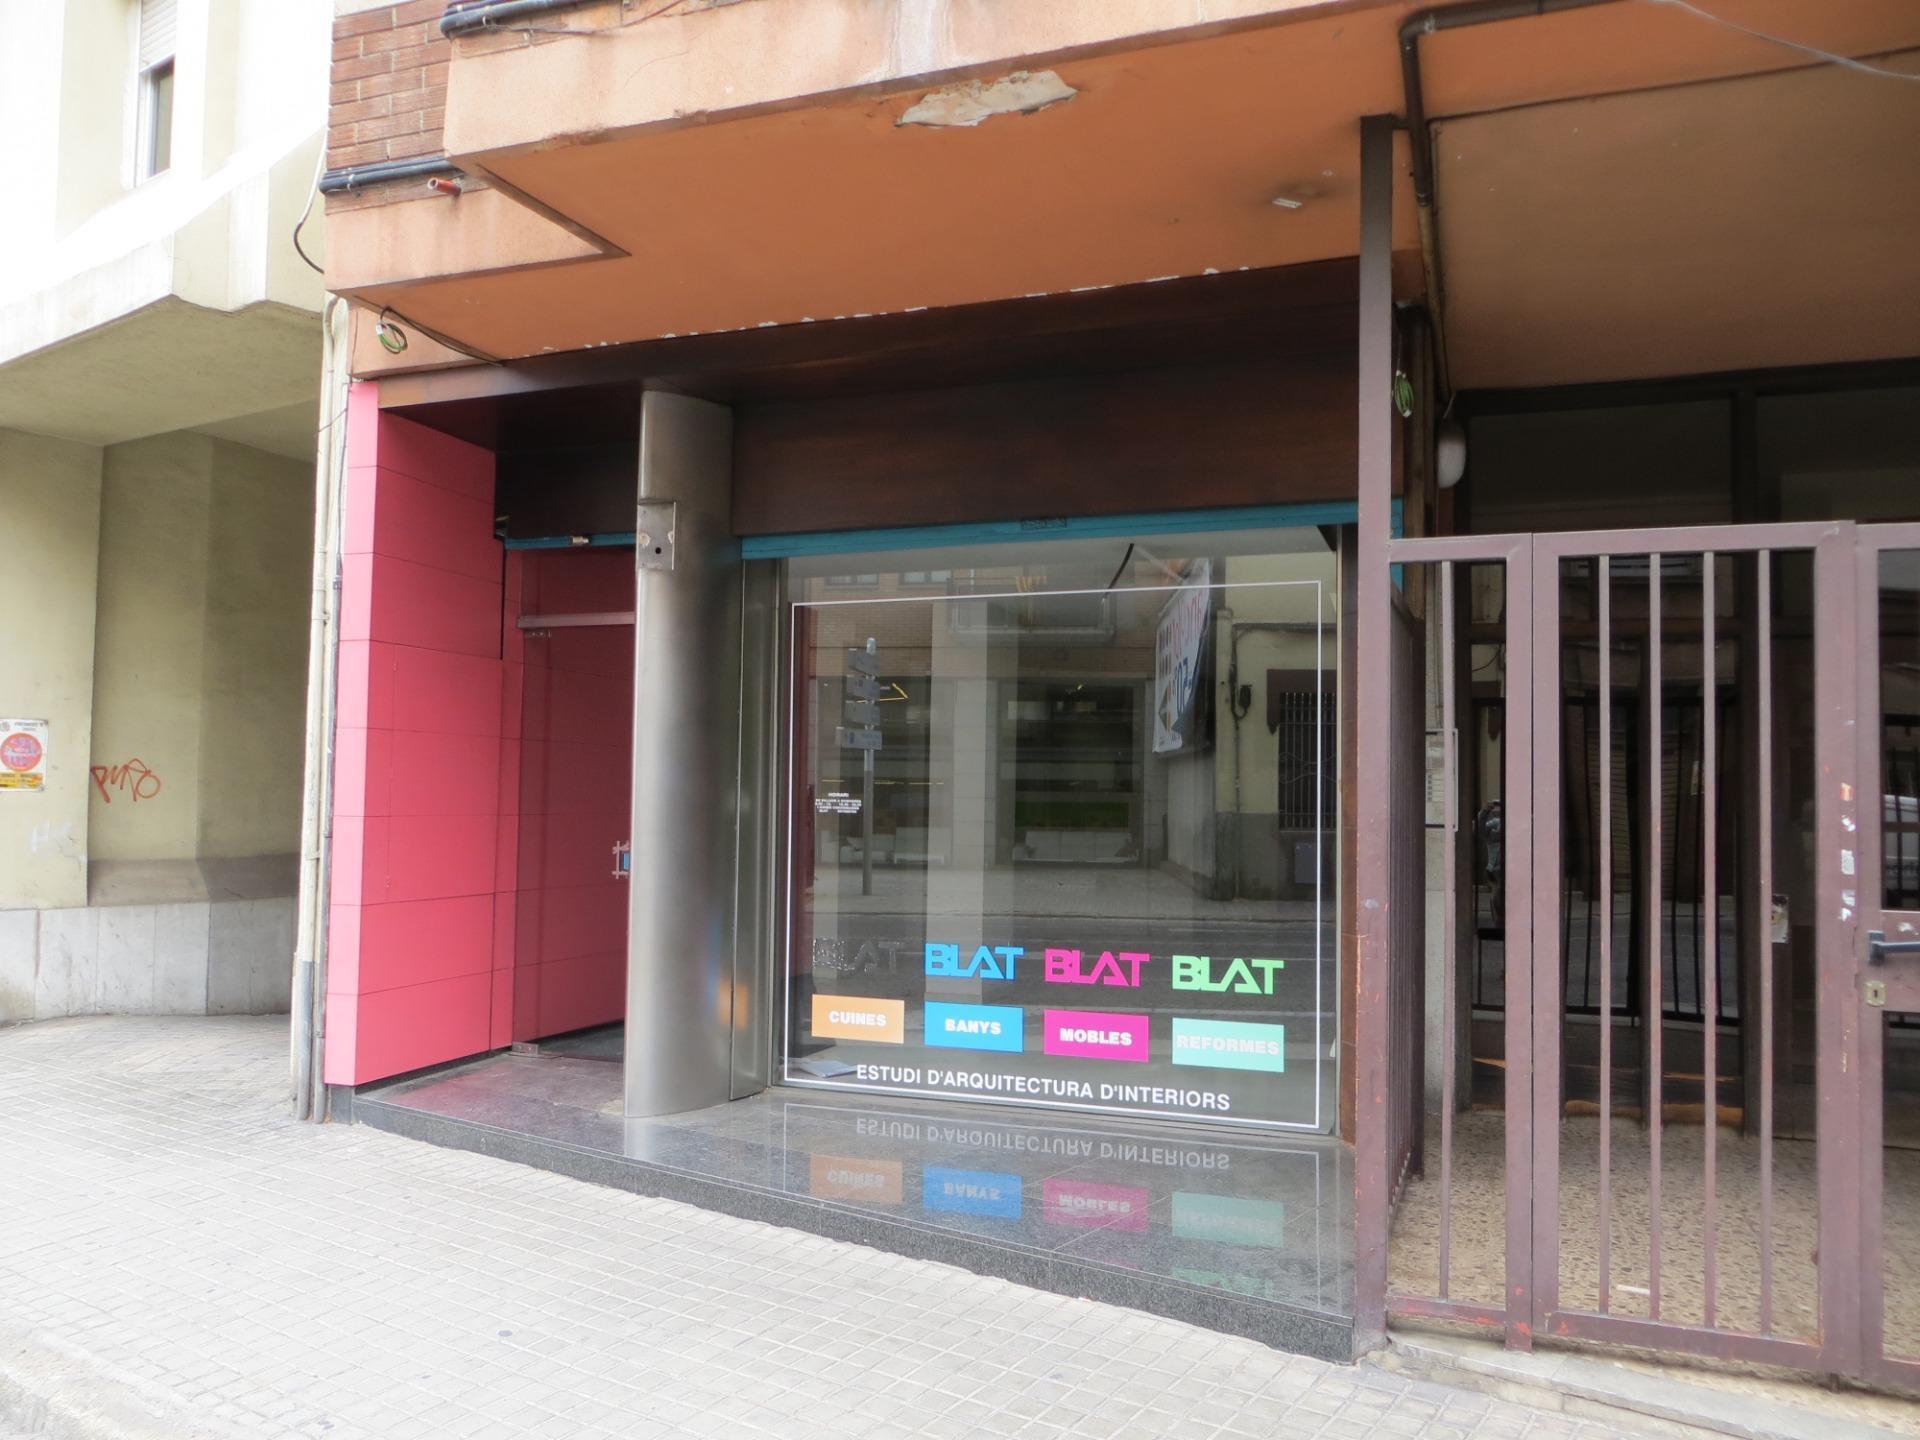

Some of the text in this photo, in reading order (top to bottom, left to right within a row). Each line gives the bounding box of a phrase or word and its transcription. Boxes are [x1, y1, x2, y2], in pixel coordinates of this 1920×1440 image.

[924, 943, 1024, 981] BLAT
[1044, 948, 1150, 987] BLAT
[1172, 955, 1285, 995] BLAT
[828, 1010, 887, 1028] CUINES
[945, 1018, 1001, 1035] BANYS
[1059, 1027, 1133, 1047] MOBLES
[1176, 1034, 1280, 1056] REFORMES
[856, 1064, 1231, 1112] ESTUDI D'ARQUITECTURA D'INTERIORS
